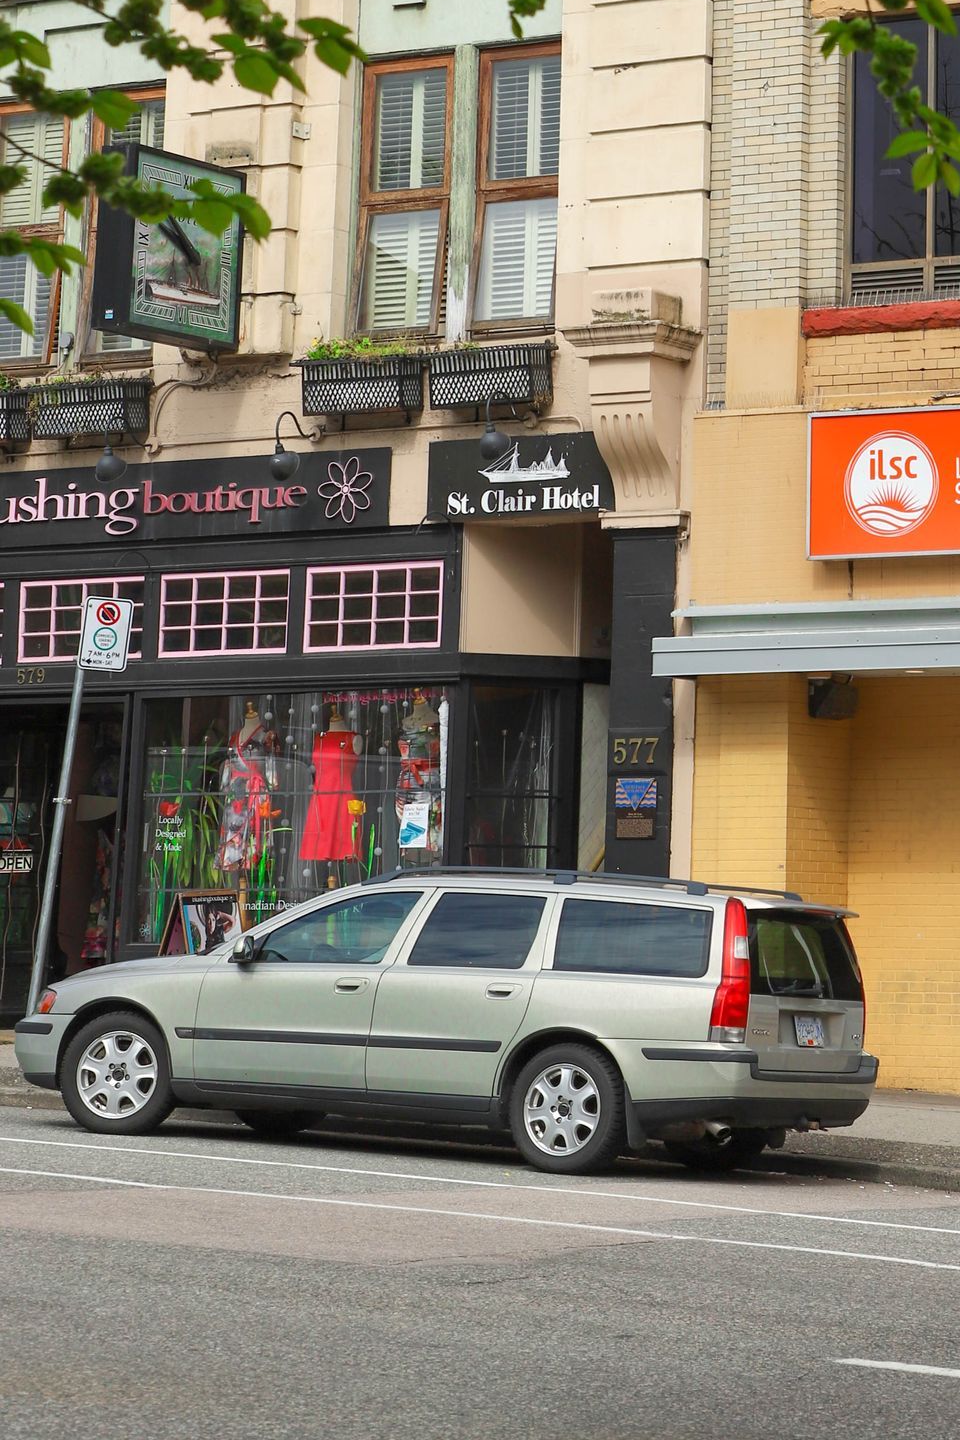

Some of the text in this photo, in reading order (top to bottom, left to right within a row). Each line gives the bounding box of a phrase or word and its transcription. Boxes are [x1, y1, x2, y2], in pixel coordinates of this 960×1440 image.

[869, 449, 918, 481] ilsc
[447, 484, 600, 516] St. Clair Hotel
[17, 667, 46, 684] 579
[613, 737, 660, 765] 577
[158, 816, 184, 827] Locally
[155, 829, 187, 840] Designed
[155, 843, 182, 851] & Made
[0, 857, 32, 870] OPEN
